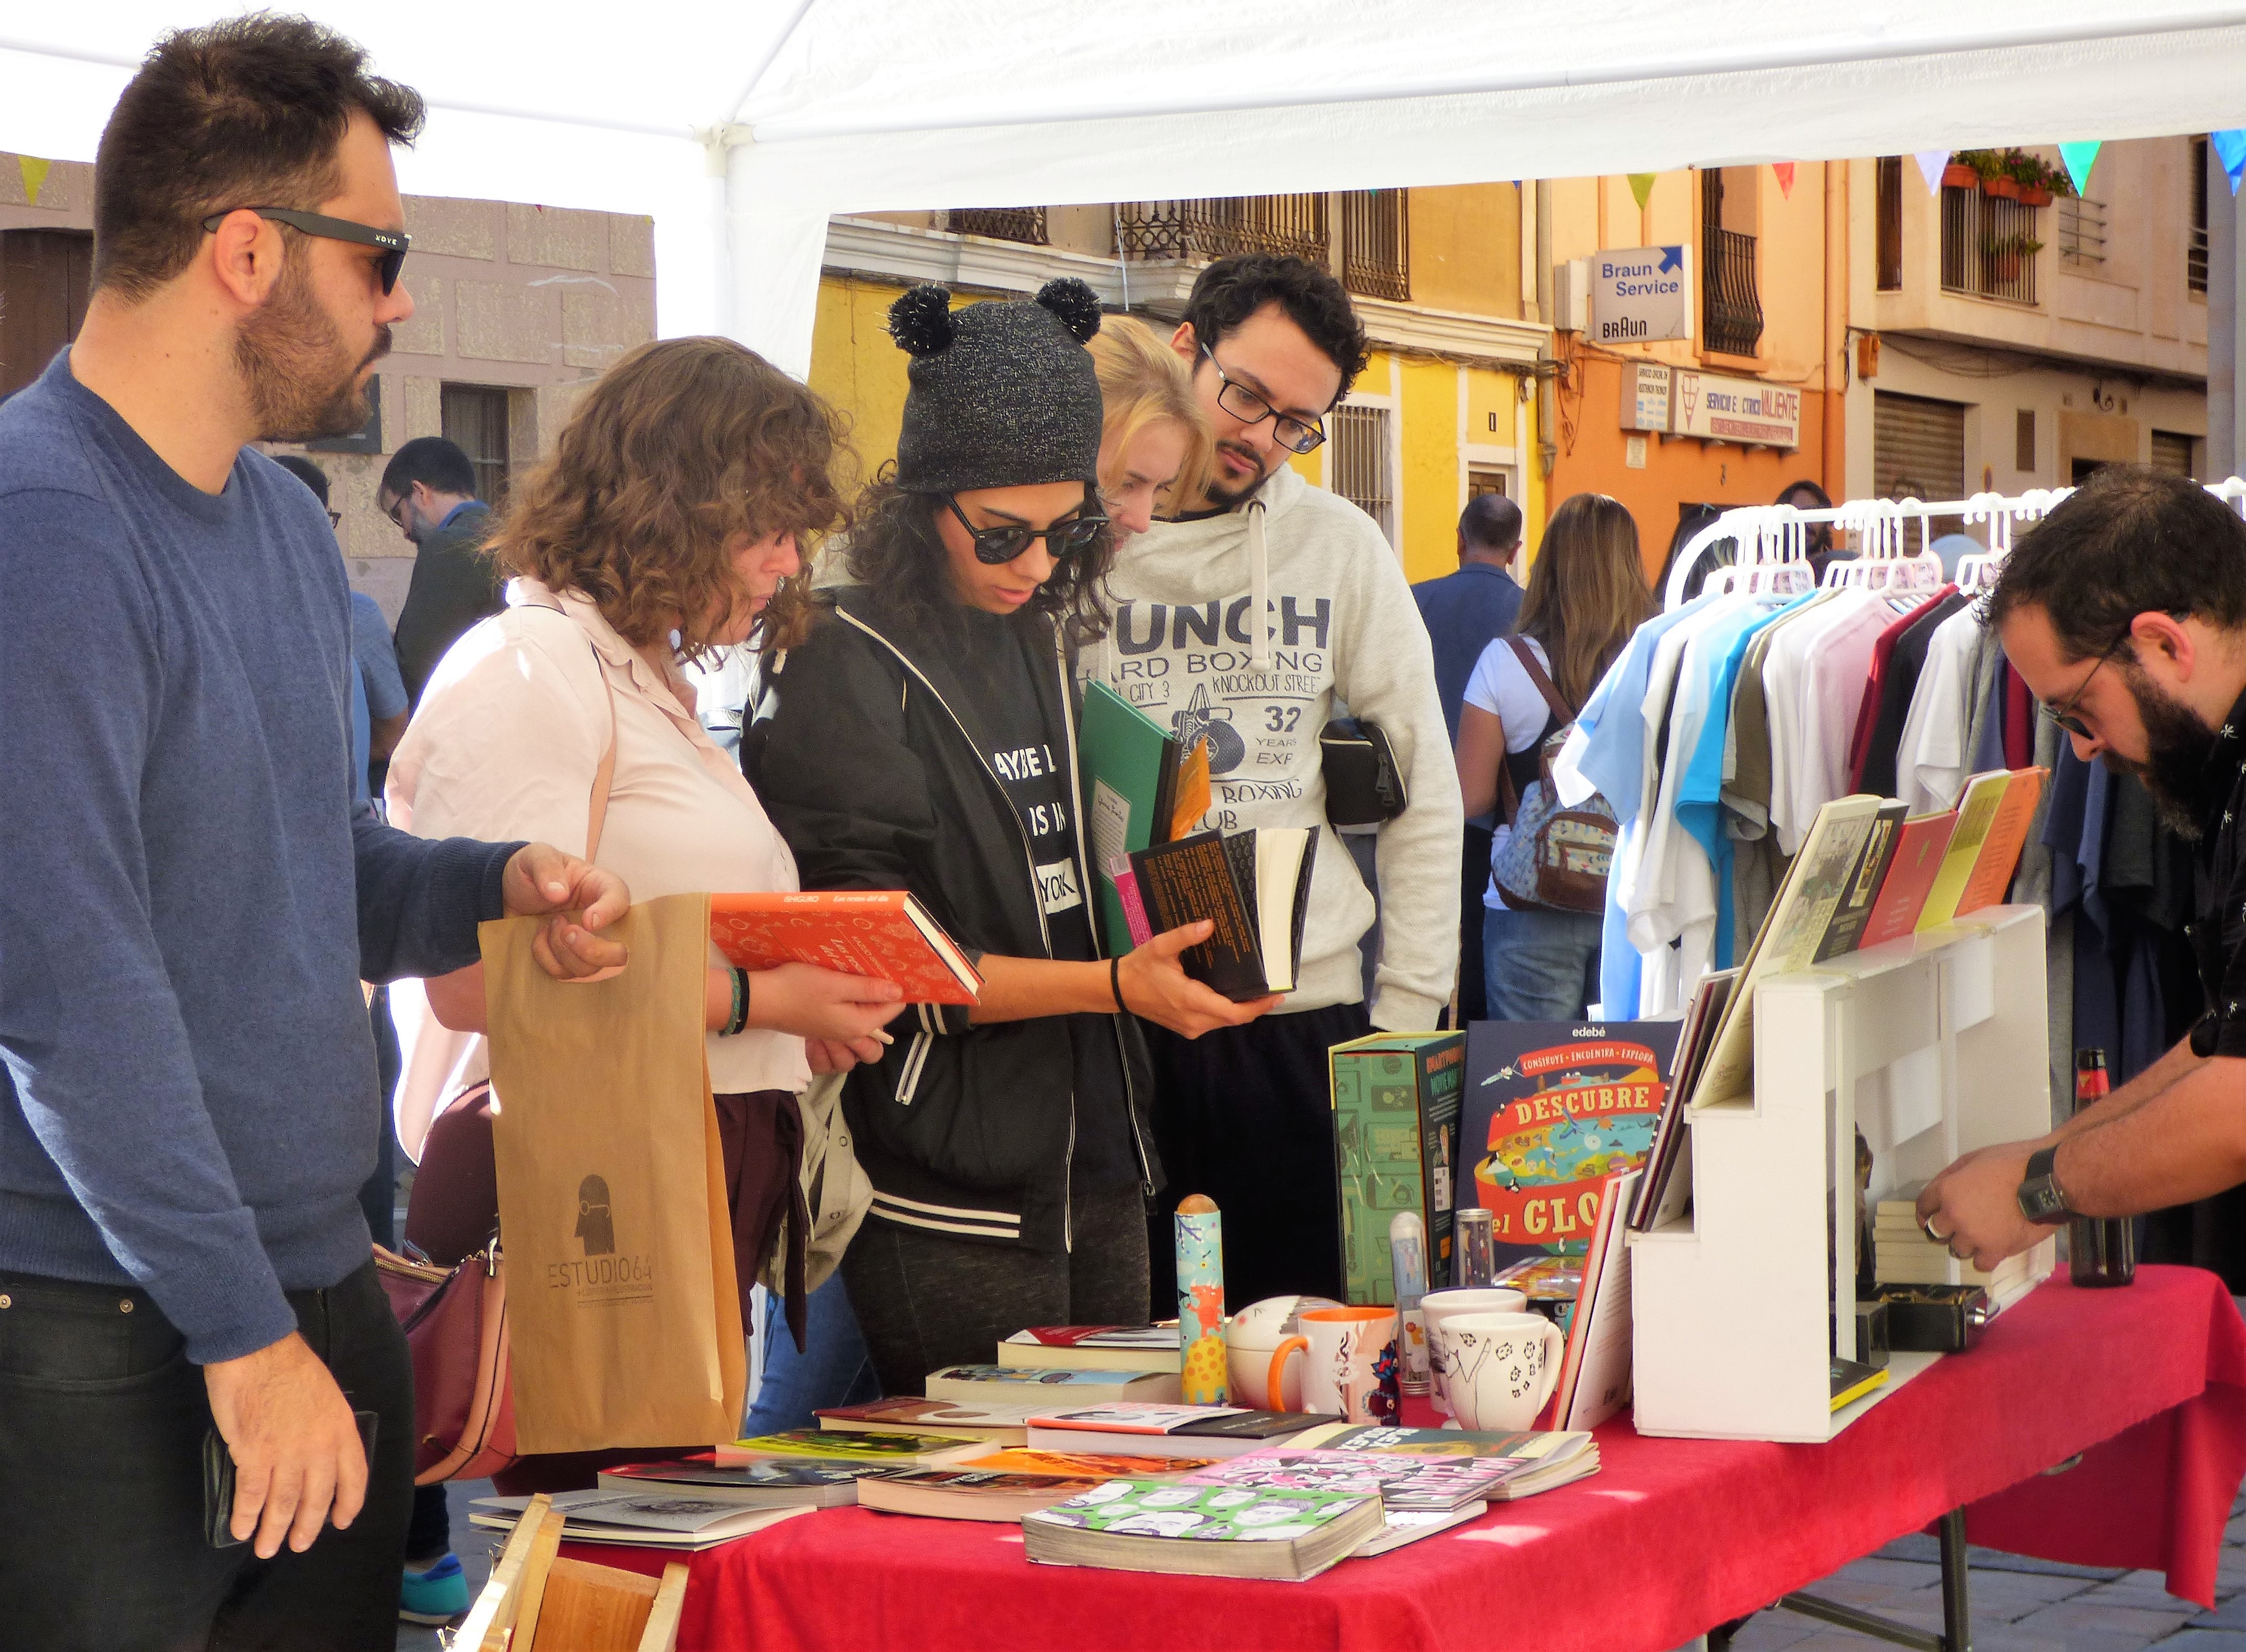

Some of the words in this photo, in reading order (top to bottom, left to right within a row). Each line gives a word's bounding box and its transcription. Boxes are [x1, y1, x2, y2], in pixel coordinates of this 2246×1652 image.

[1602, 263, 1652, 279] Braun
[1616, 279, 1679, 297] Service
[1603, 316, 1647, 338] BRAUN
[1116, 596, 1331, 656] UNCH
[1187, 651, 1323, 673] BOXNG
[1130, 682, 1154, 703] CITY
[1162, 680, 1170, 698] 3
[1212, 673, 1280, 694] KNOCKOUT
[1264, 705, 1302, 732] 32
[994, 746, 1043, 781] AYBE
[1221, 778, 1303, 804] BOXING
[1029, 804, 1050, 837] IS
[1192, 810, 1238, 831] UB
[1571, 1026, 1606, 1037] edebé
[1523, 1053, 1564, 1070] CONSTRUYE
[1571, 1048, 1615, 1062] ENCUENTRA
[1621, 1048, 1654, 1064] EXPLORA
[1515, 1086, 1650, 1125] DESCUBRE
[1492, 1214, 1510, 1234] el
[1523, 1191, 1599, 1235] GLO
